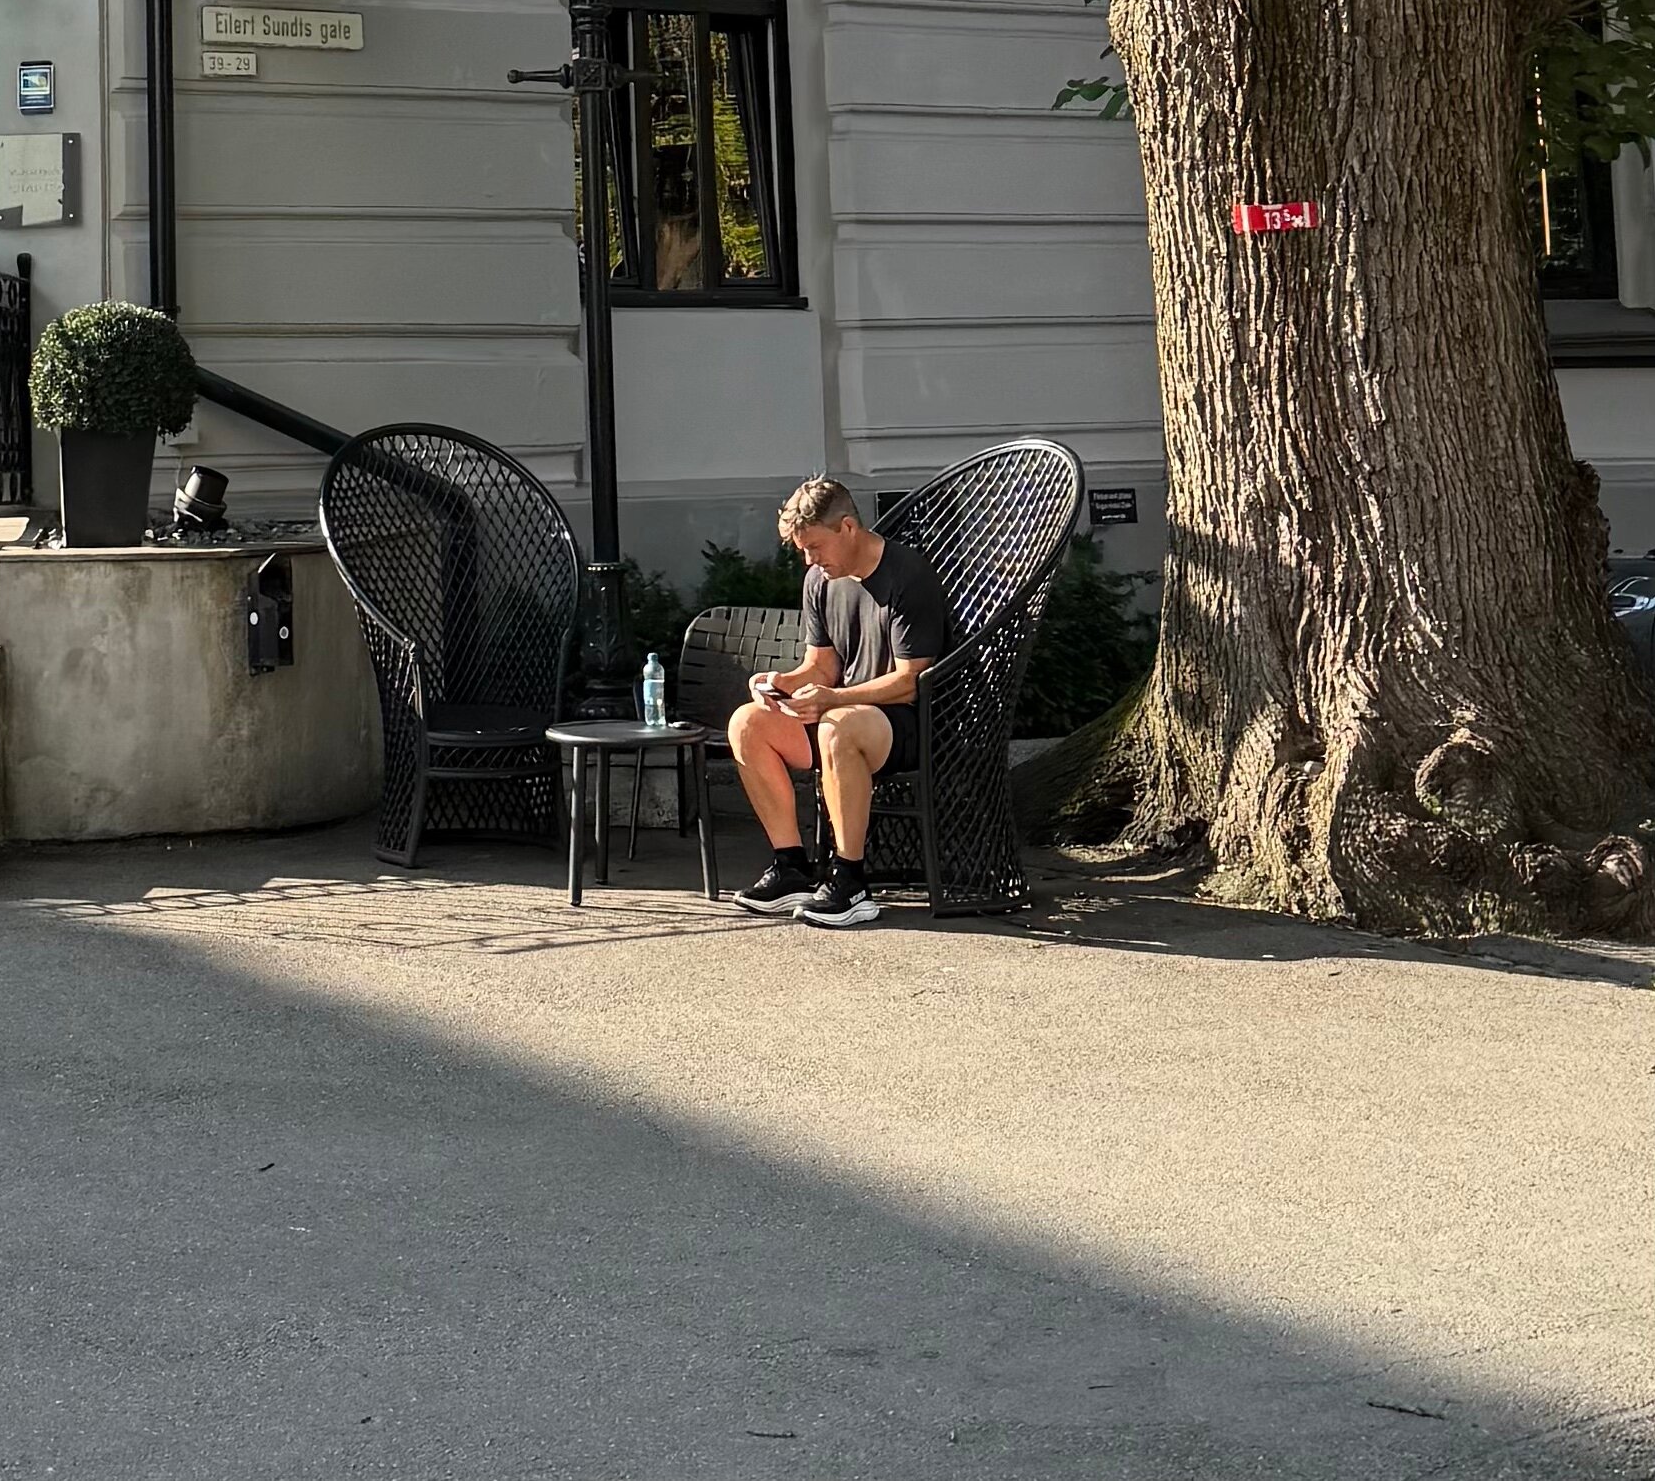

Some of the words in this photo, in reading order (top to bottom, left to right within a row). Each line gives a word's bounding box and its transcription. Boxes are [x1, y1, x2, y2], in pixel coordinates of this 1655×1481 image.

[215, 13, 255, 36] Eilert
[263, 15, 312, 37] Sundts
[320, 18, 351, 44] gate
